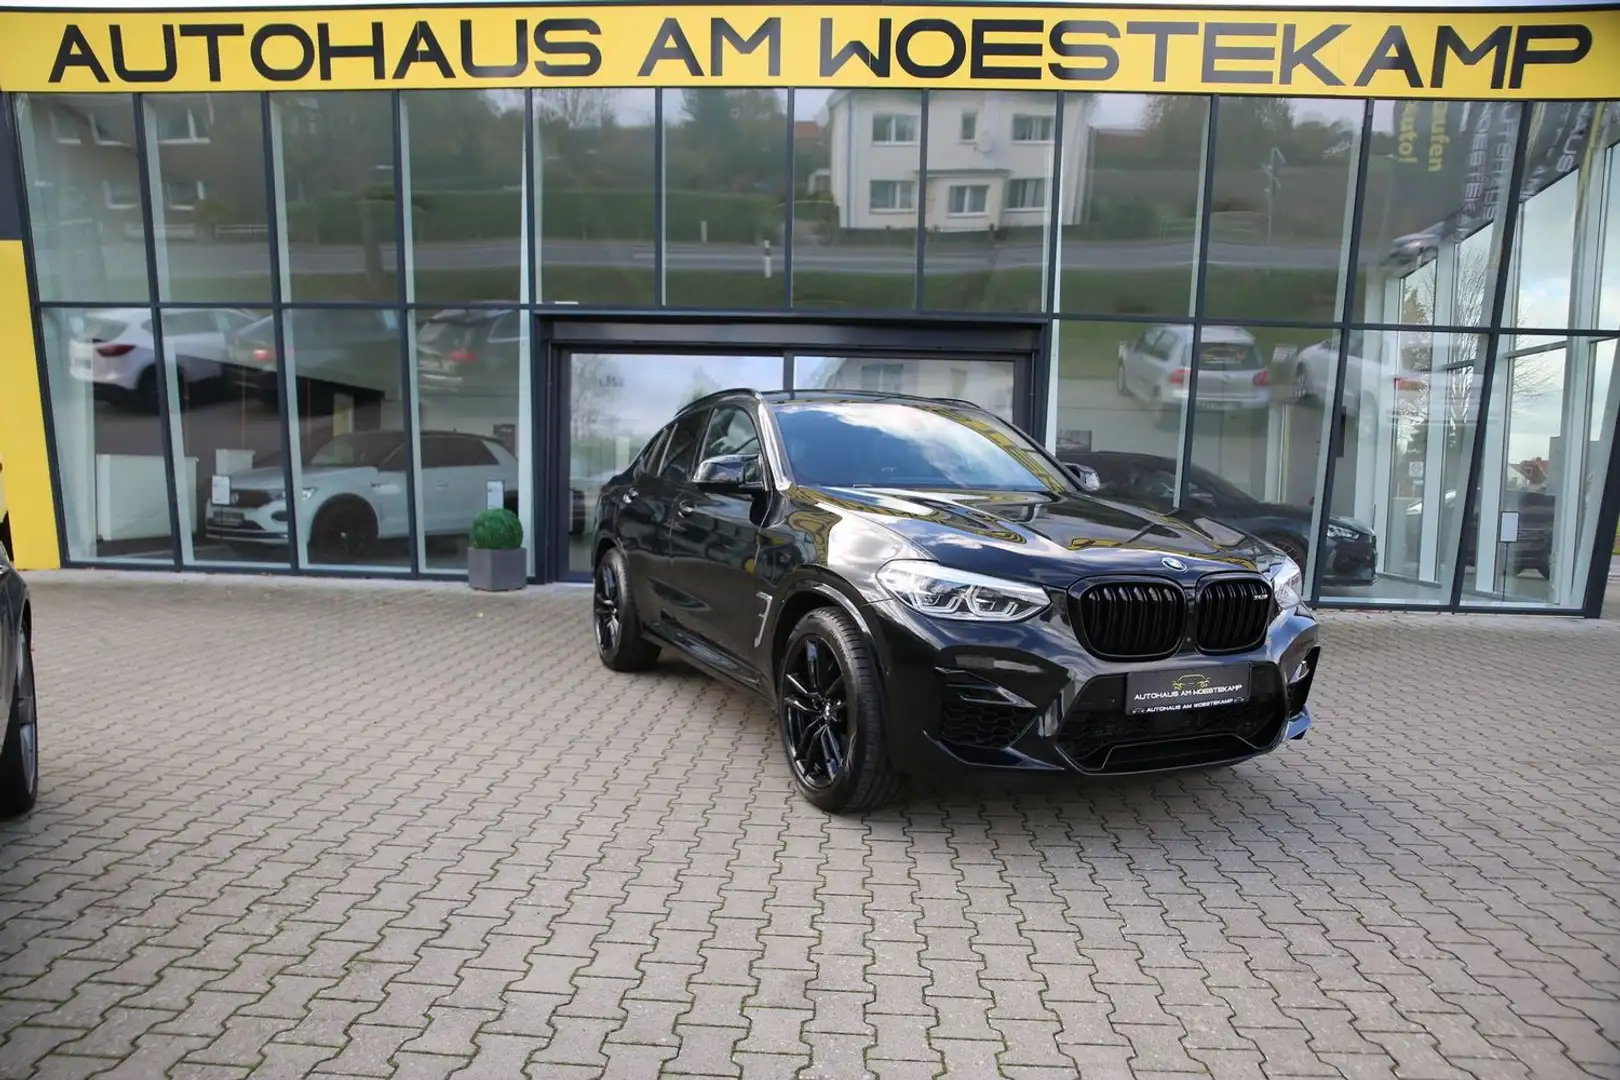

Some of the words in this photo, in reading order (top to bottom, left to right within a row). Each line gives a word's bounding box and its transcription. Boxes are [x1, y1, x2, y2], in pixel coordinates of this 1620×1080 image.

[48, 18, 602, 84] AUTOHAUS
[637, 16, 781, 78] AM
[819, 17, 1594, 90] WOESTEKAMP
[1133, 690, 1179, 701] AUTOHAUS
[1193, 684, 1243, 696] WOESTEKAMP
[1145, 704, 1181, 713] AUTOHAUS
[1193, 698, 1234, 708] WOESTEKAMP
